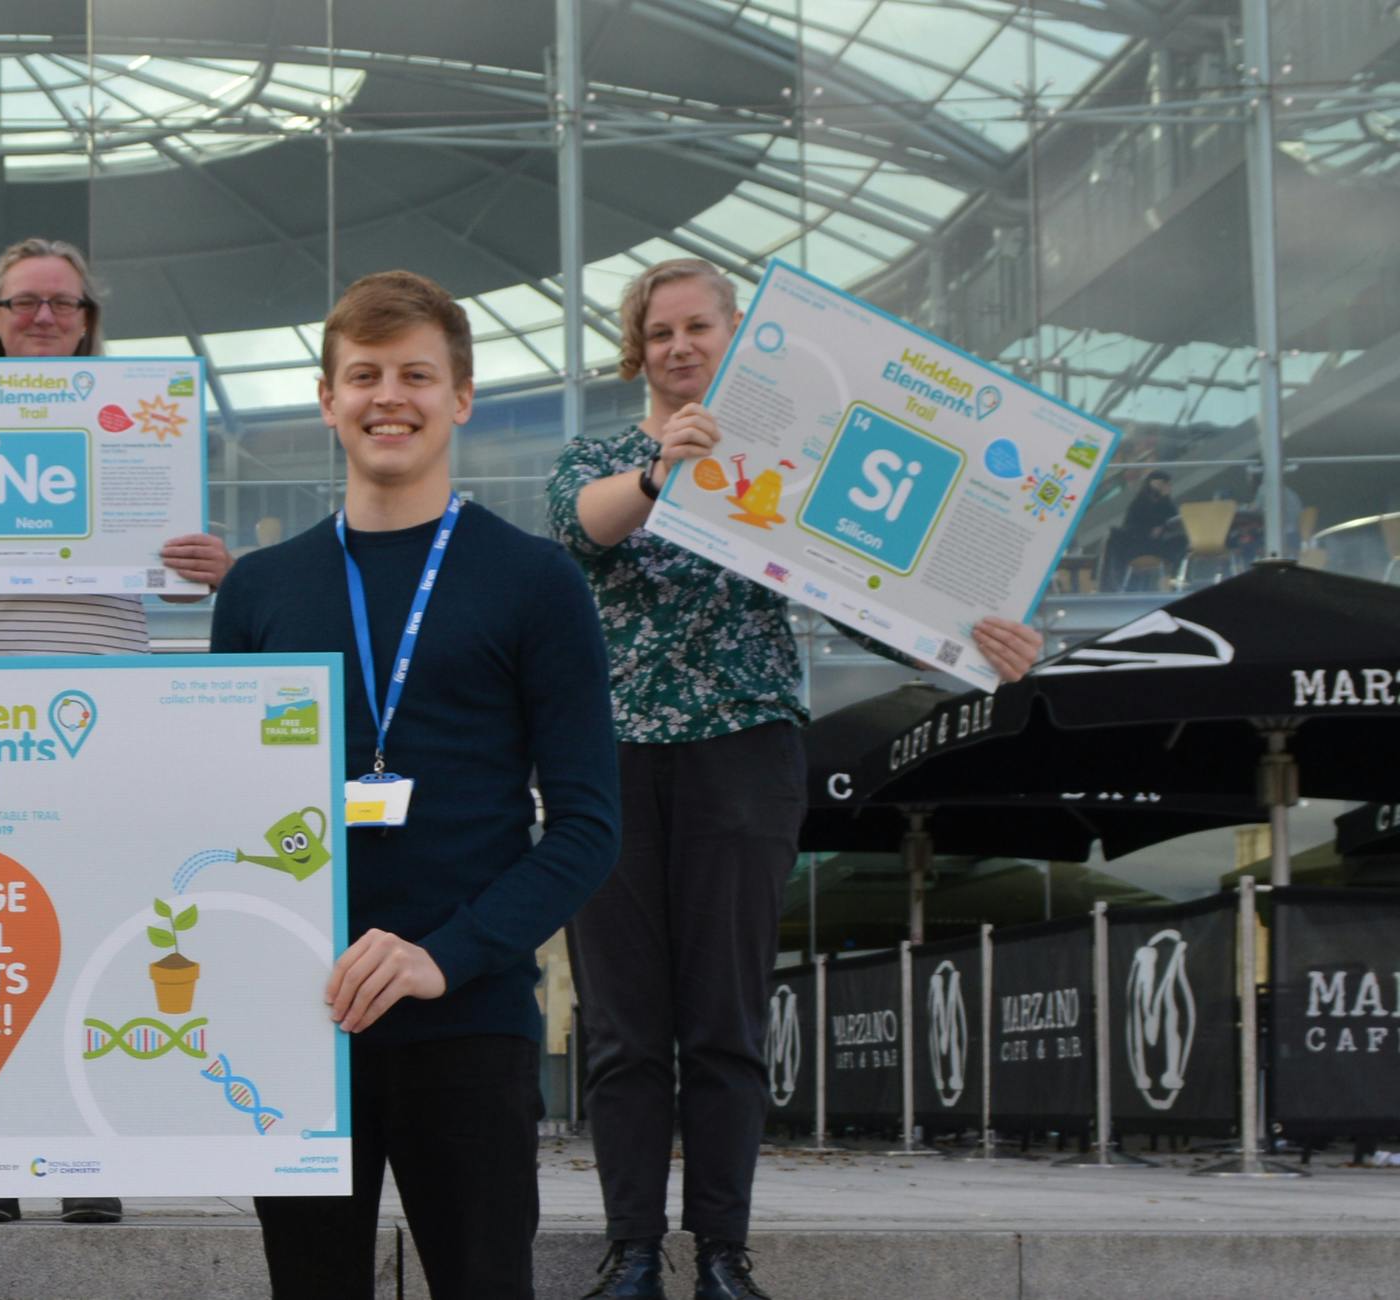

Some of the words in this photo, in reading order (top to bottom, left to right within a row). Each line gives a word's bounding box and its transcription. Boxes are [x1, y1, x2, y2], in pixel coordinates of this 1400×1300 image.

[900, 347, 974, 398] Hidden
[881, 361, 974, 418] Elements
[19, 406, 48, 419] Trail
[853, 412, 872, 431] 14
[904, 395, 939, 422] Trail
[848, 448, 923, 522] Si
[15, 517, 53, 529] Neon
[835, 516, 884, 550] Silicon
[159, 694, 194, 705] collect
[199, 694, 215, 704] the
[171, 680, 186, 690] Do
[190, 680, 207, 690] the
[211, 680, 232, 690] trail
[236, 680, 258, 690] and
[1292, 668, 1400, 706] MAR
[957, 695, 995, 738] BAR
[32, 810, 61, 821] TRAIL
[1001, 987, 1080, 1034] MARZANO
[832, 1009, 897, 1046] MARZANO
[1304, 1026, 1400, 1053] CAF
